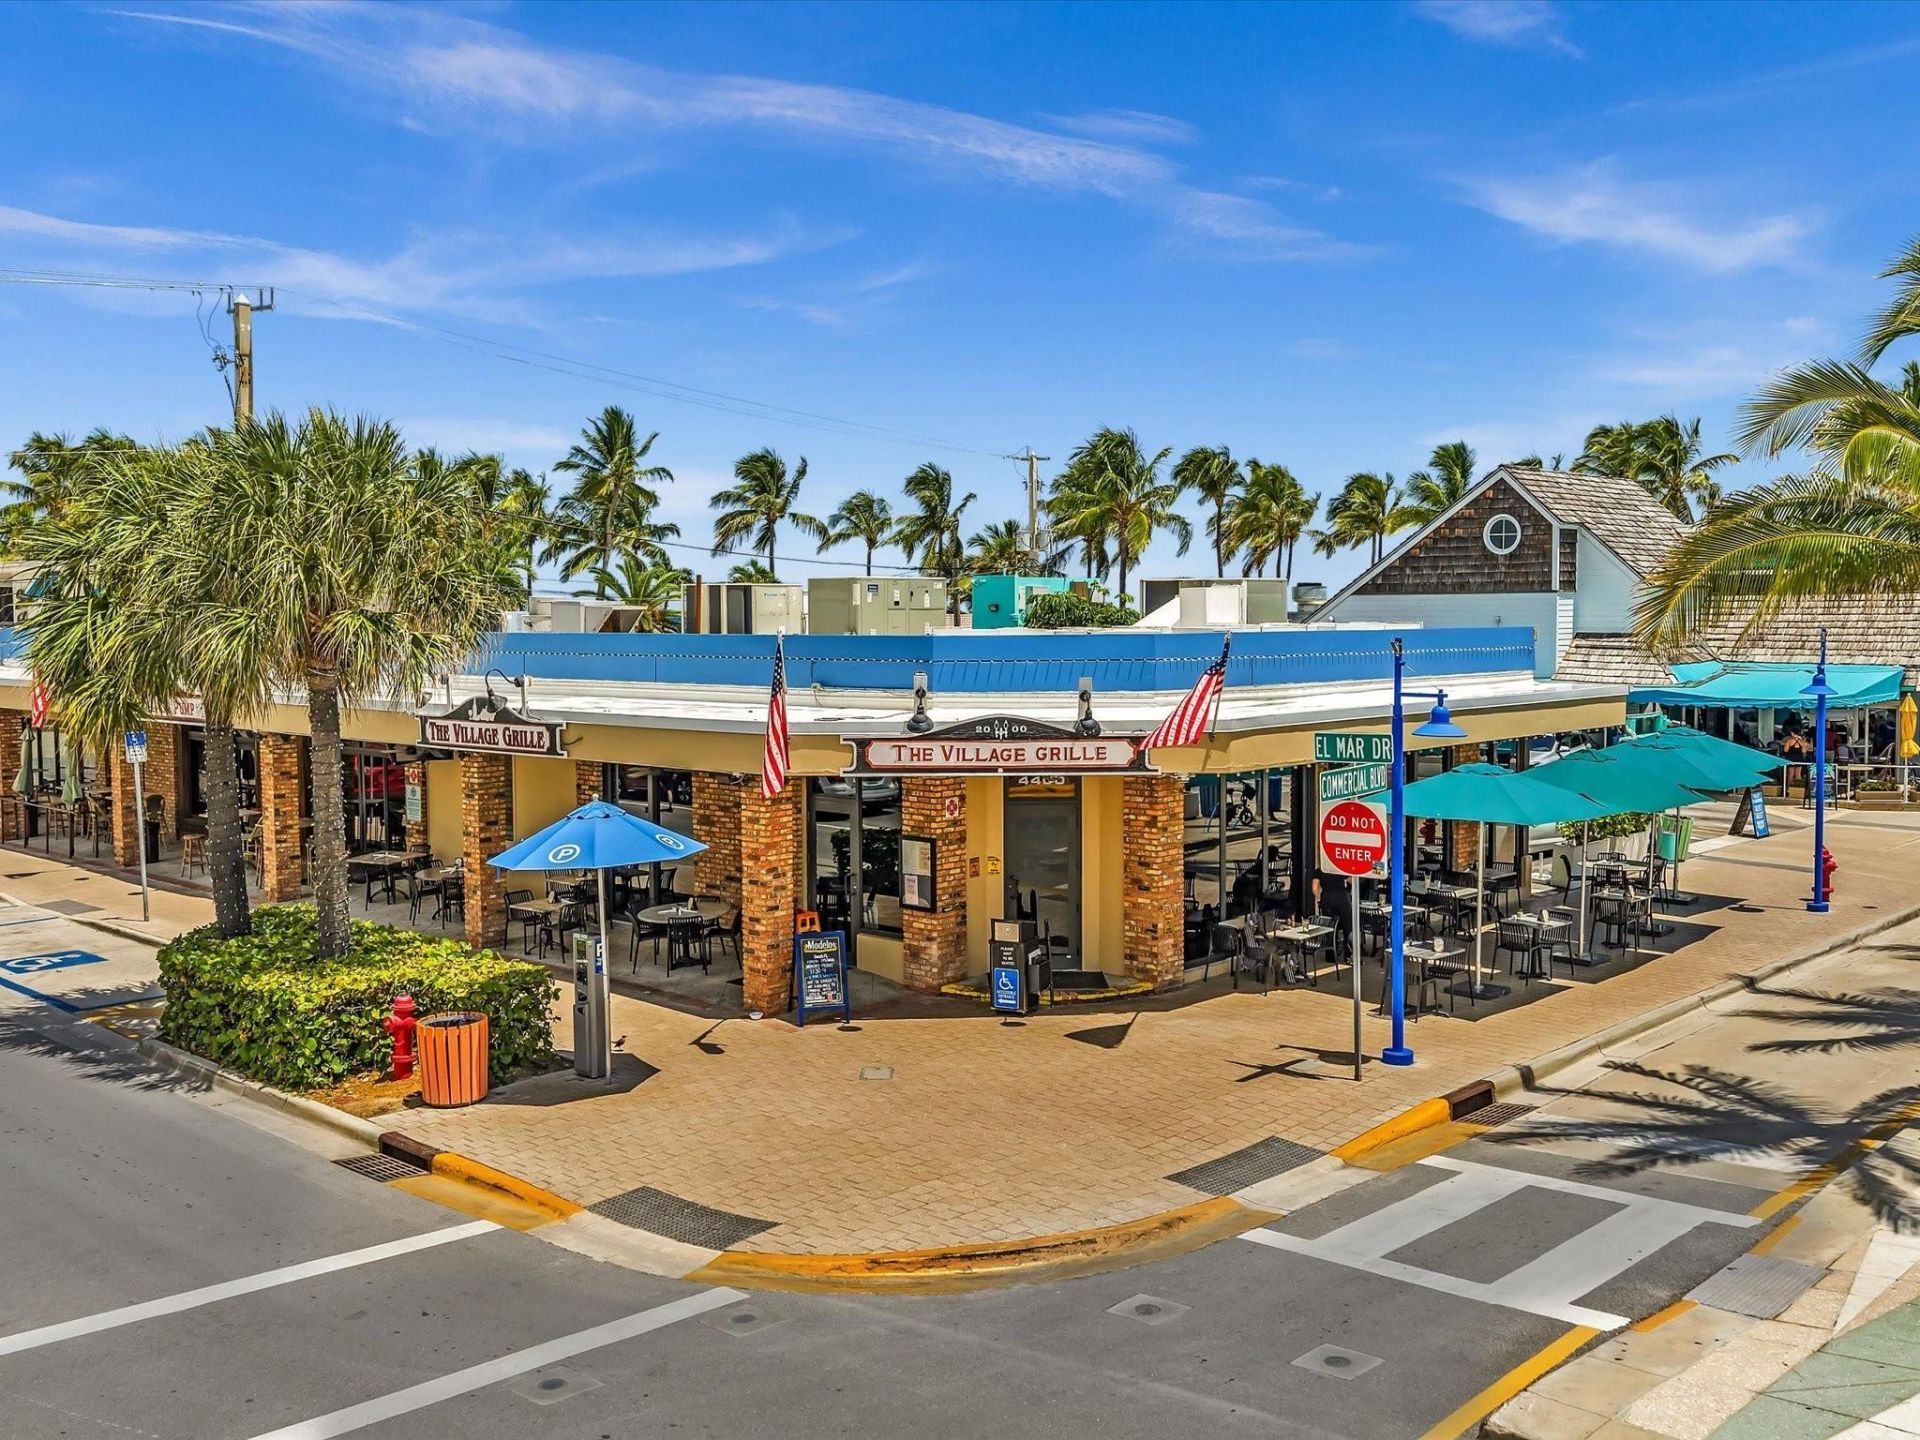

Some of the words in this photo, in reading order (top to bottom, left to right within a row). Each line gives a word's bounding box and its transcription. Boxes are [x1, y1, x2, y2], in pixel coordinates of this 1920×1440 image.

[429, 721, 450, 742] THE
[452, 723, 499, 746] VILLAGE
[502, 726, 545, 749] GRILLE
[975, 725, 991, 733] 20
[1011, 725, 1028, 733] 00
[892, 744, 934, 762] THE
[941, 745, 1026, 762] VILLAGE
[1035, 746, 1107, 762] GRILLE
[1316, 736, 1331, 758] EL
[1372, 737, 1391, 760] DR
[1321, 768, 1368, 798] COMMERCIAL
[1370, 765, 1386, 789] BLVD
[1330, 815, 1346, 827] DO
[1351, 817, 1376, 829] NOT
[557, 848, 574, 860] P
[1335, 848, 1372, 862] ENTER
